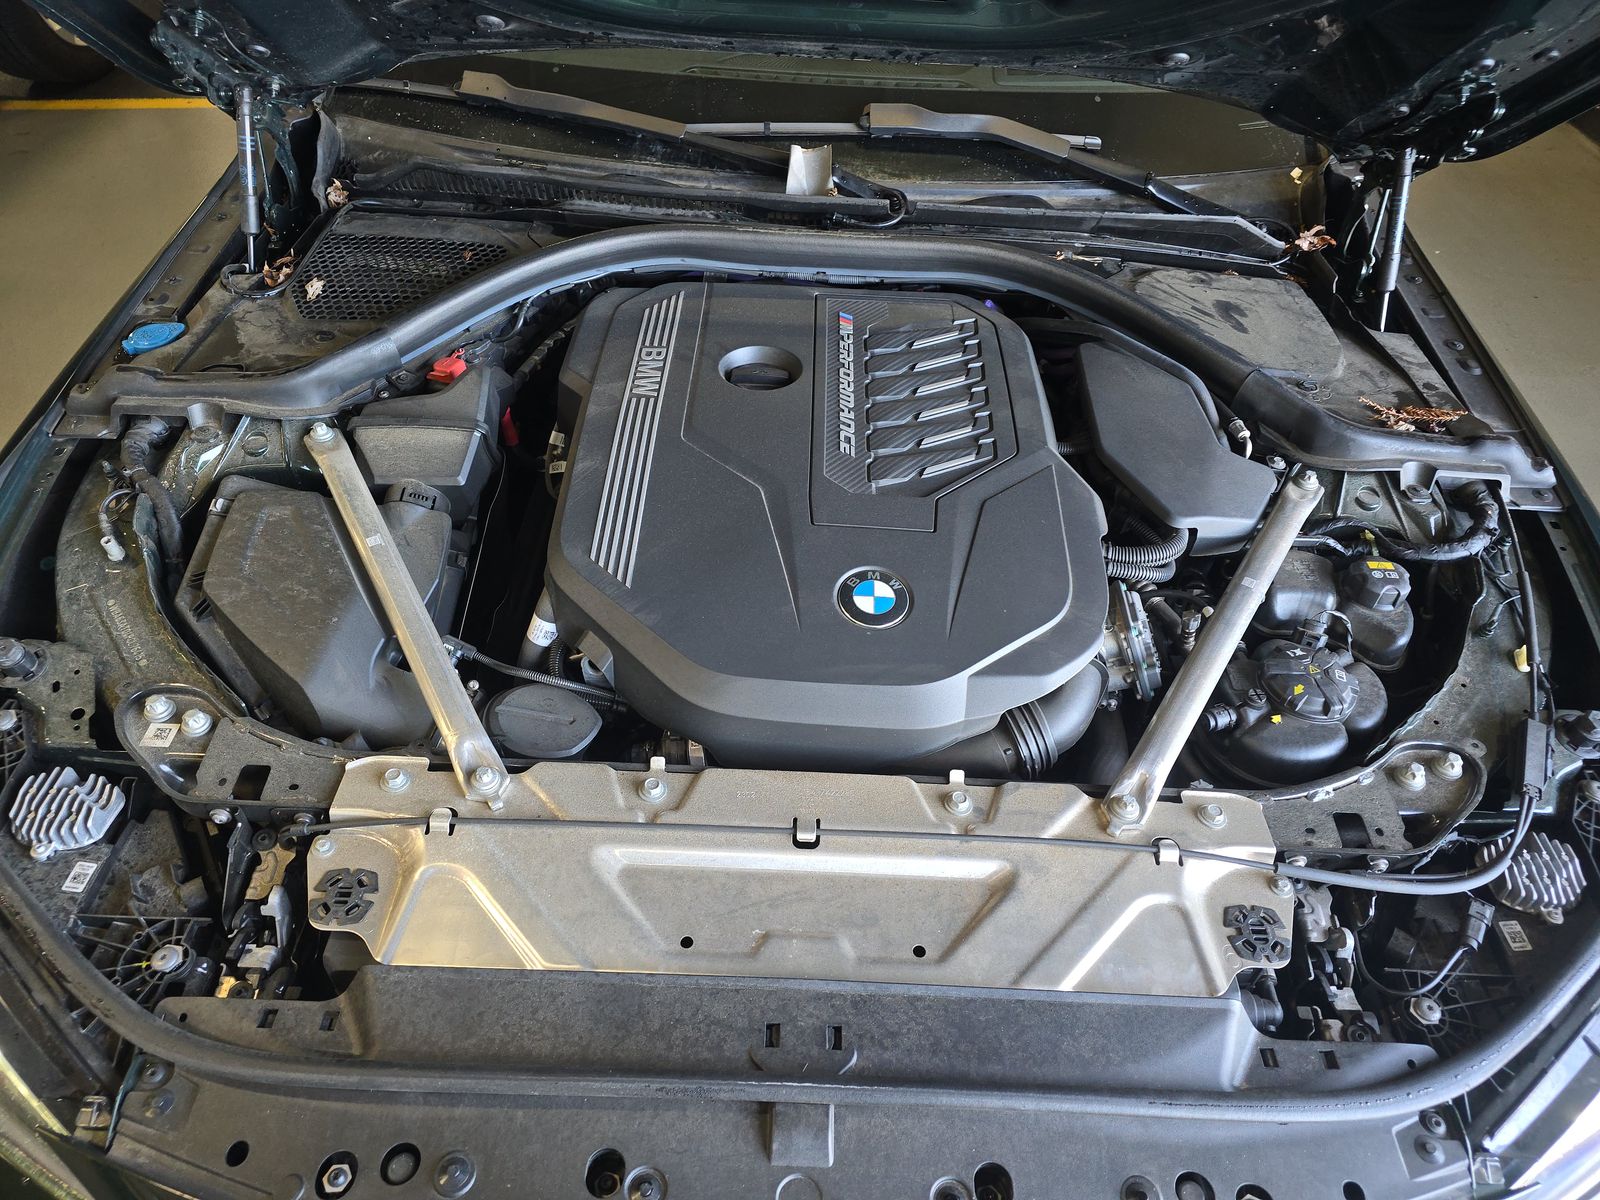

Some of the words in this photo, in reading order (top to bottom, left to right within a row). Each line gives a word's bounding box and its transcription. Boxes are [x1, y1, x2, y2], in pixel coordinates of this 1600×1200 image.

[632, 347, 667, 397] BMW
[839, 332, 856, 458] PERFORMANCE
[846, 571, 903, 590] BMW
